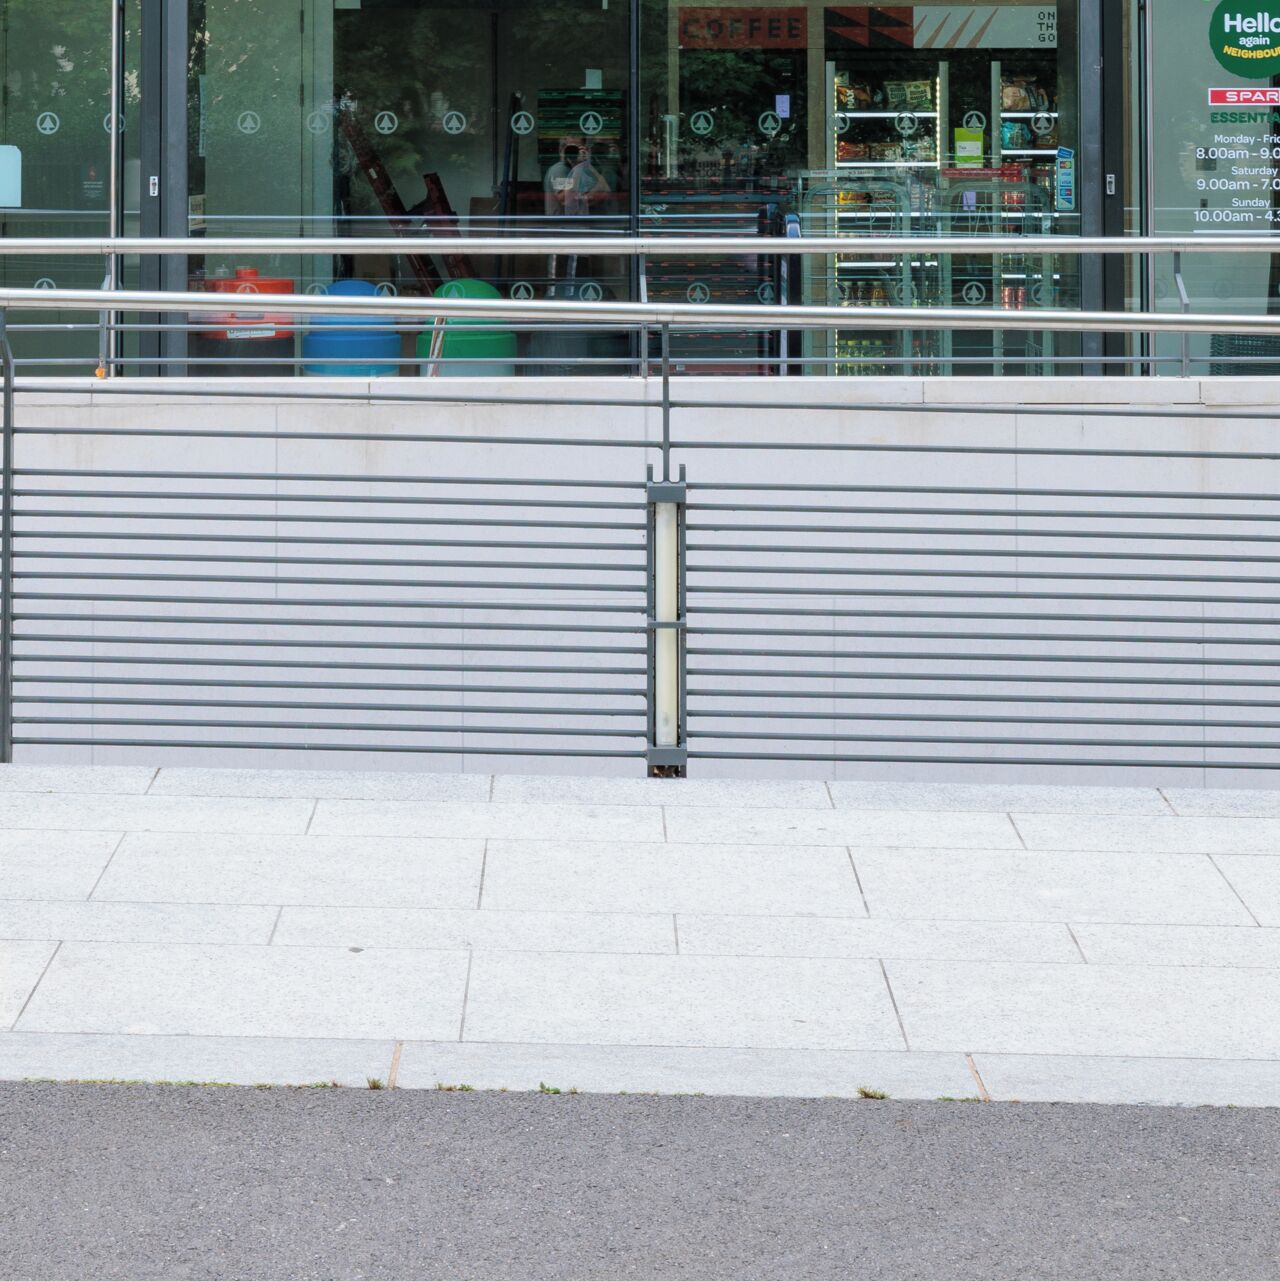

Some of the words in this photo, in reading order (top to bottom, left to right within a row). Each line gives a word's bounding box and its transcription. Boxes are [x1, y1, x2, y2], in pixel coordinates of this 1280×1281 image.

[1038, 11, 1056, 21] ON
[683, 17, 801, 39] COFFEE
[1036, 22, 1055, 31] TH
[1038, 33, 1056, 42] GO
[1238, 34, 1271, 47] again
[1225, 91, 1279, 102] SPAR
[1214, 134, 1255, 145] Monday
[1196, 147, 1249, 159] 8.00am
[1231, 166, 1278, 177] Saturday
[1196, 179, 1250, 190] 9.00am
[1231, 198, 1271, 209] Sunday
[1193, 210, 1253, 222] 10.00am
